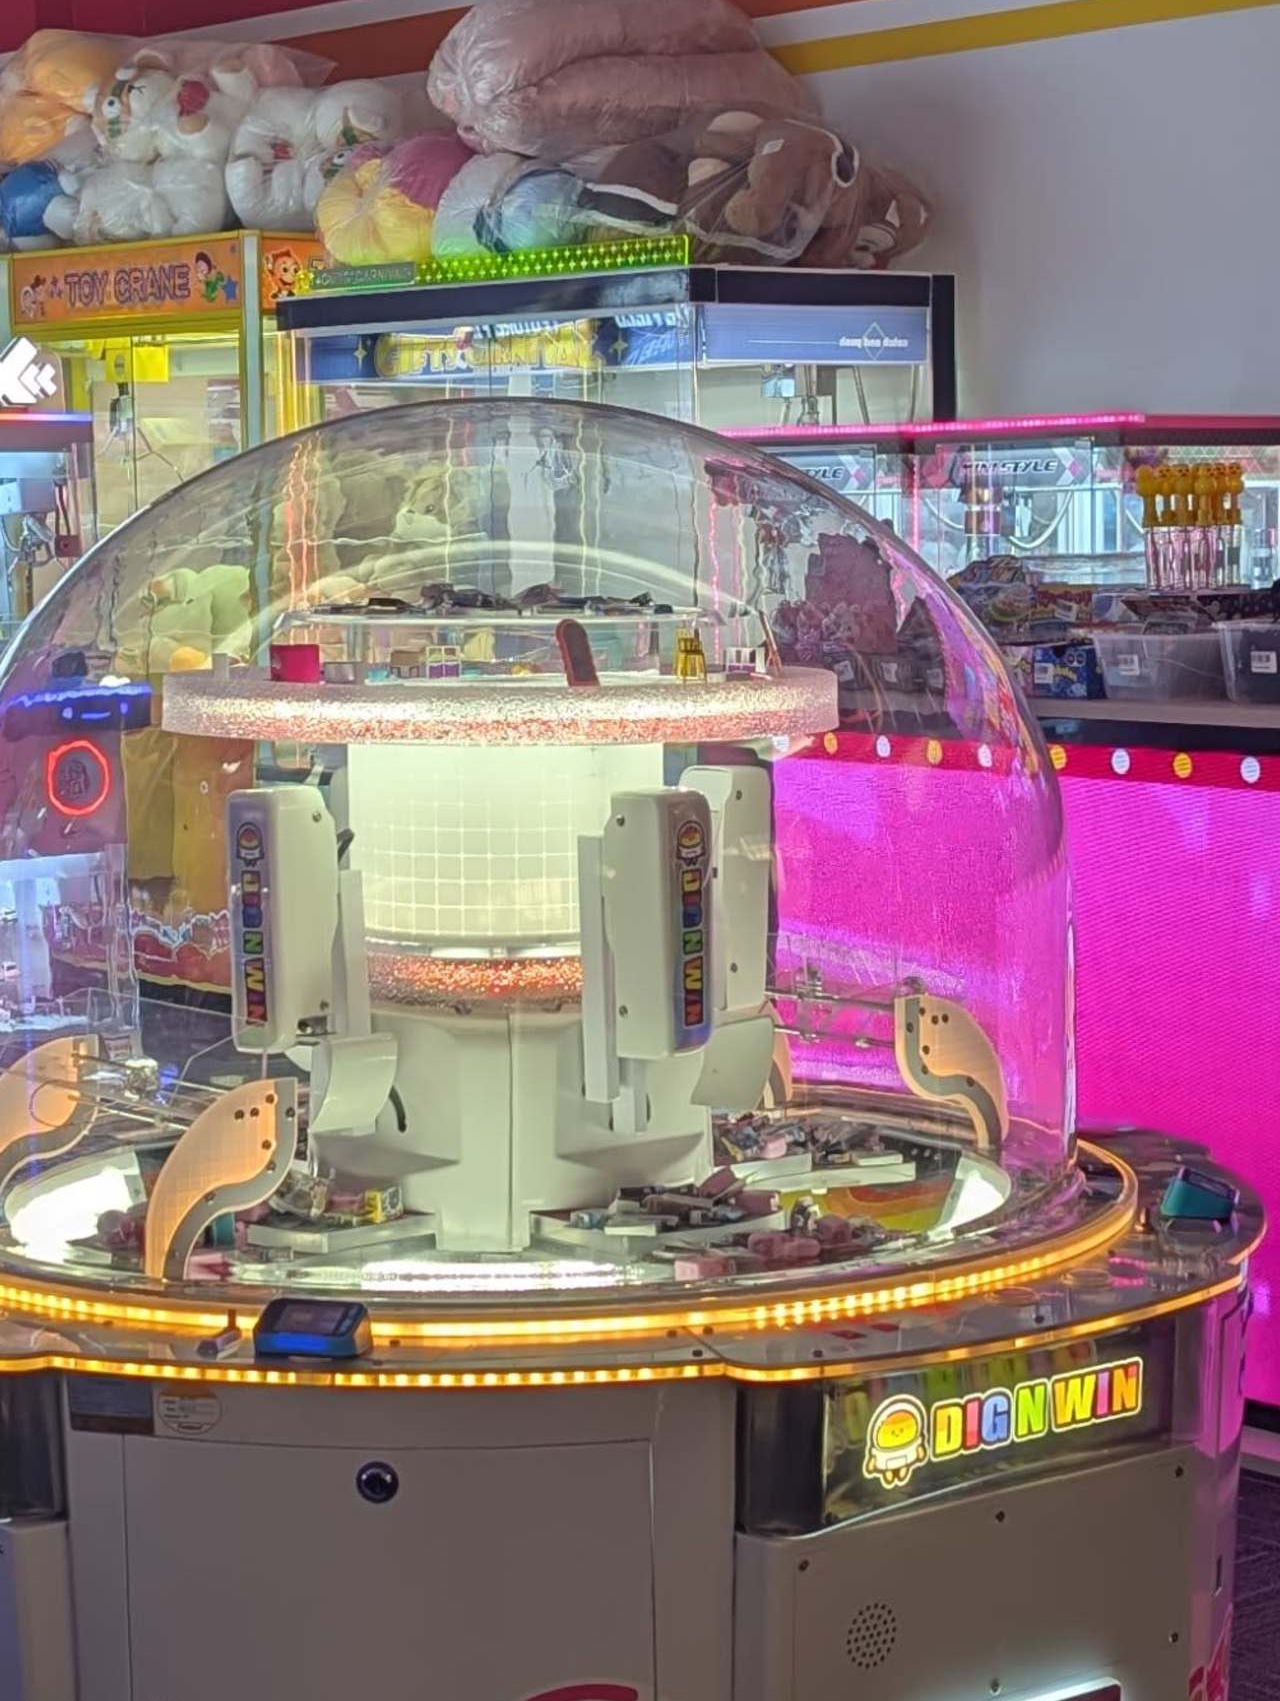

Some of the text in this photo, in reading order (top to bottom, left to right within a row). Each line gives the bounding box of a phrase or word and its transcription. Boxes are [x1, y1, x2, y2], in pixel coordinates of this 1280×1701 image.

[63, 262, 192, 311] TOY CRANE
[999, 457, 1059, 475] STYLE
